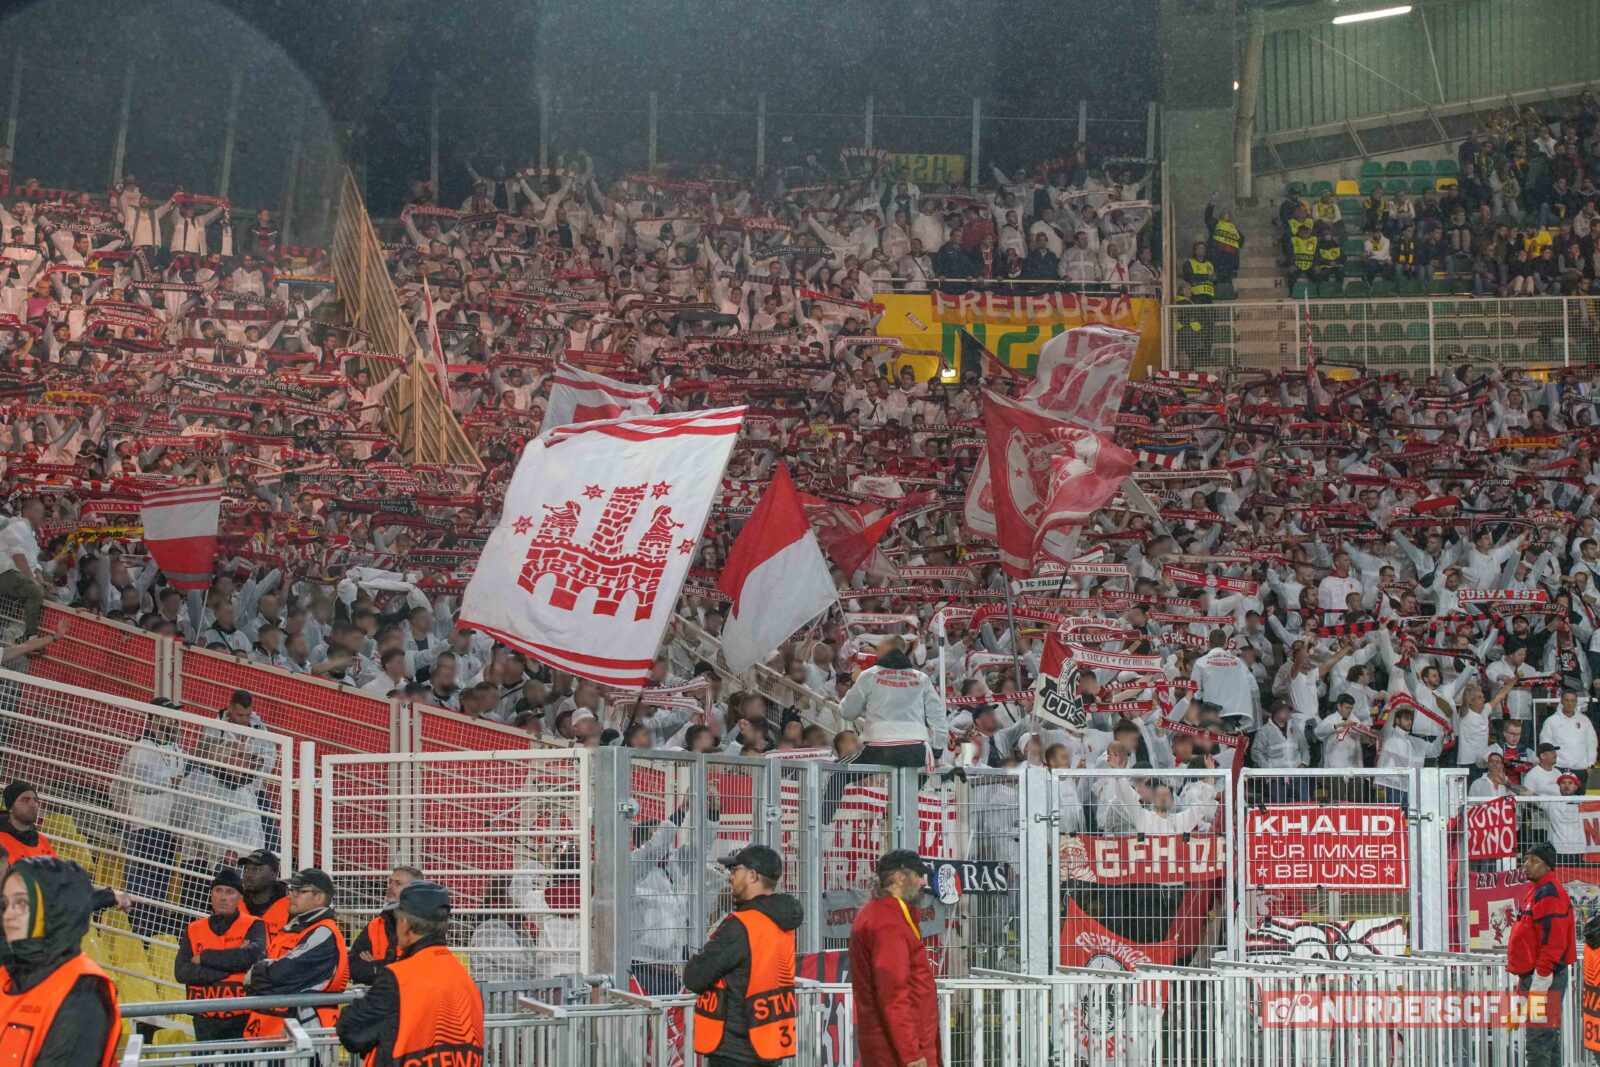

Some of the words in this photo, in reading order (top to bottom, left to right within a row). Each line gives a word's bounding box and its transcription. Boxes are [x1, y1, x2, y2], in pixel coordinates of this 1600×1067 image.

[936, 293, 1133, 320] FREIBURG
[251, 378, 276, 388] BERLIN
[287, 383, 313, 395] BERLIN
[909, 424, 973, 433] FREIBURG
[1389, 477, 1421, 490] freiburg
[380, 504, 409, 516] freiburg
[409, 555, 434, 563] NUR
[434, 555, 456, 563] DER
[923, 568, 970, 578] FREIBURG
[1084, 565, 1127, 574] FREIBURG
[1458, 588, 1507, 600] CURVA
[1512, 589, 1541, 600] EST
[1070, 599, 1098, 608] FREIBURG
[1081, 652, 1111, 665] FORZA
[1117, 657, 1157, 668] FREIBURG
[1164, 680, 1193, 688] ULTRAS
[1108, 702, 1140, 711] ULTRAS
[1254, 815, 1396, 837] KHALID
[1254, 840, 1306, 860] FÜR
[1313, 844, 1399, 861] IMMER
[1275, 864, 1314, 879] BEI
[1320, 863, 1379, 879] UNS
